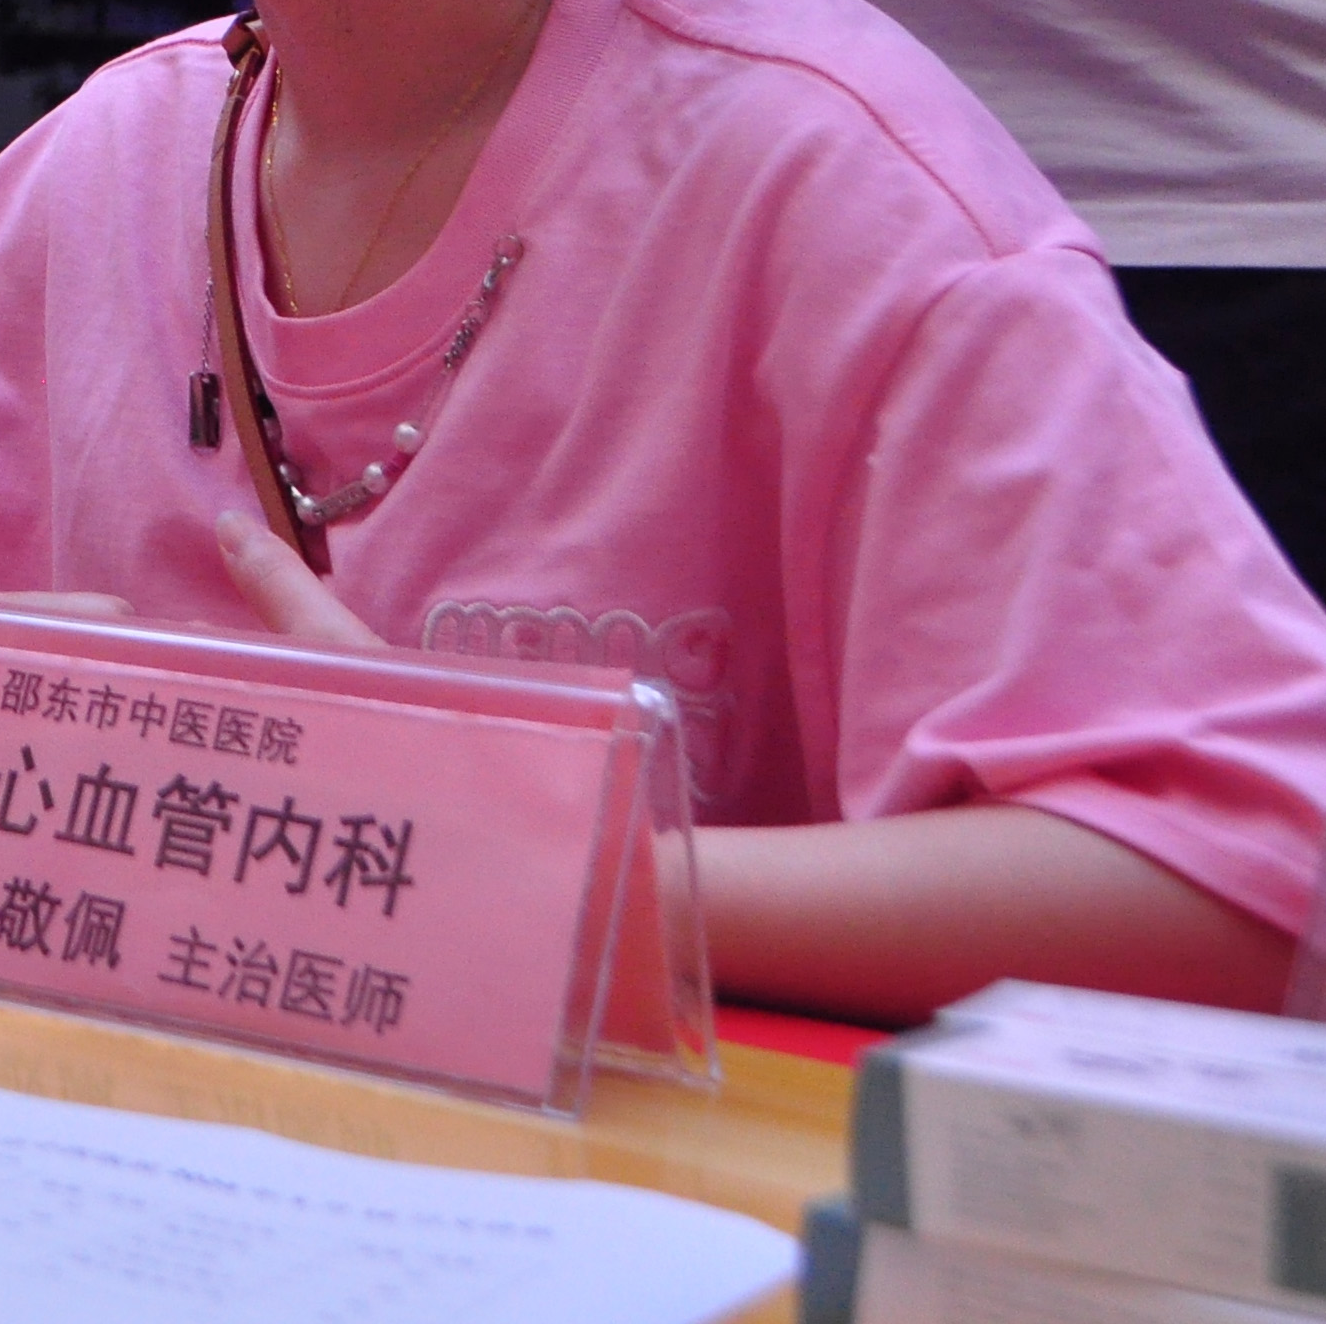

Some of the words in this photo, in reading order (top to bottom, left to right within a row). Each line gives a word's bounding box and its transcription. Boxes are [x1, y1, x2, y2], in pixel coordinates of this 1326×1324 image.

[0, 668, 305, 765] 邵东市中医医院
[156, 924, 413, 1035] 主治医师
